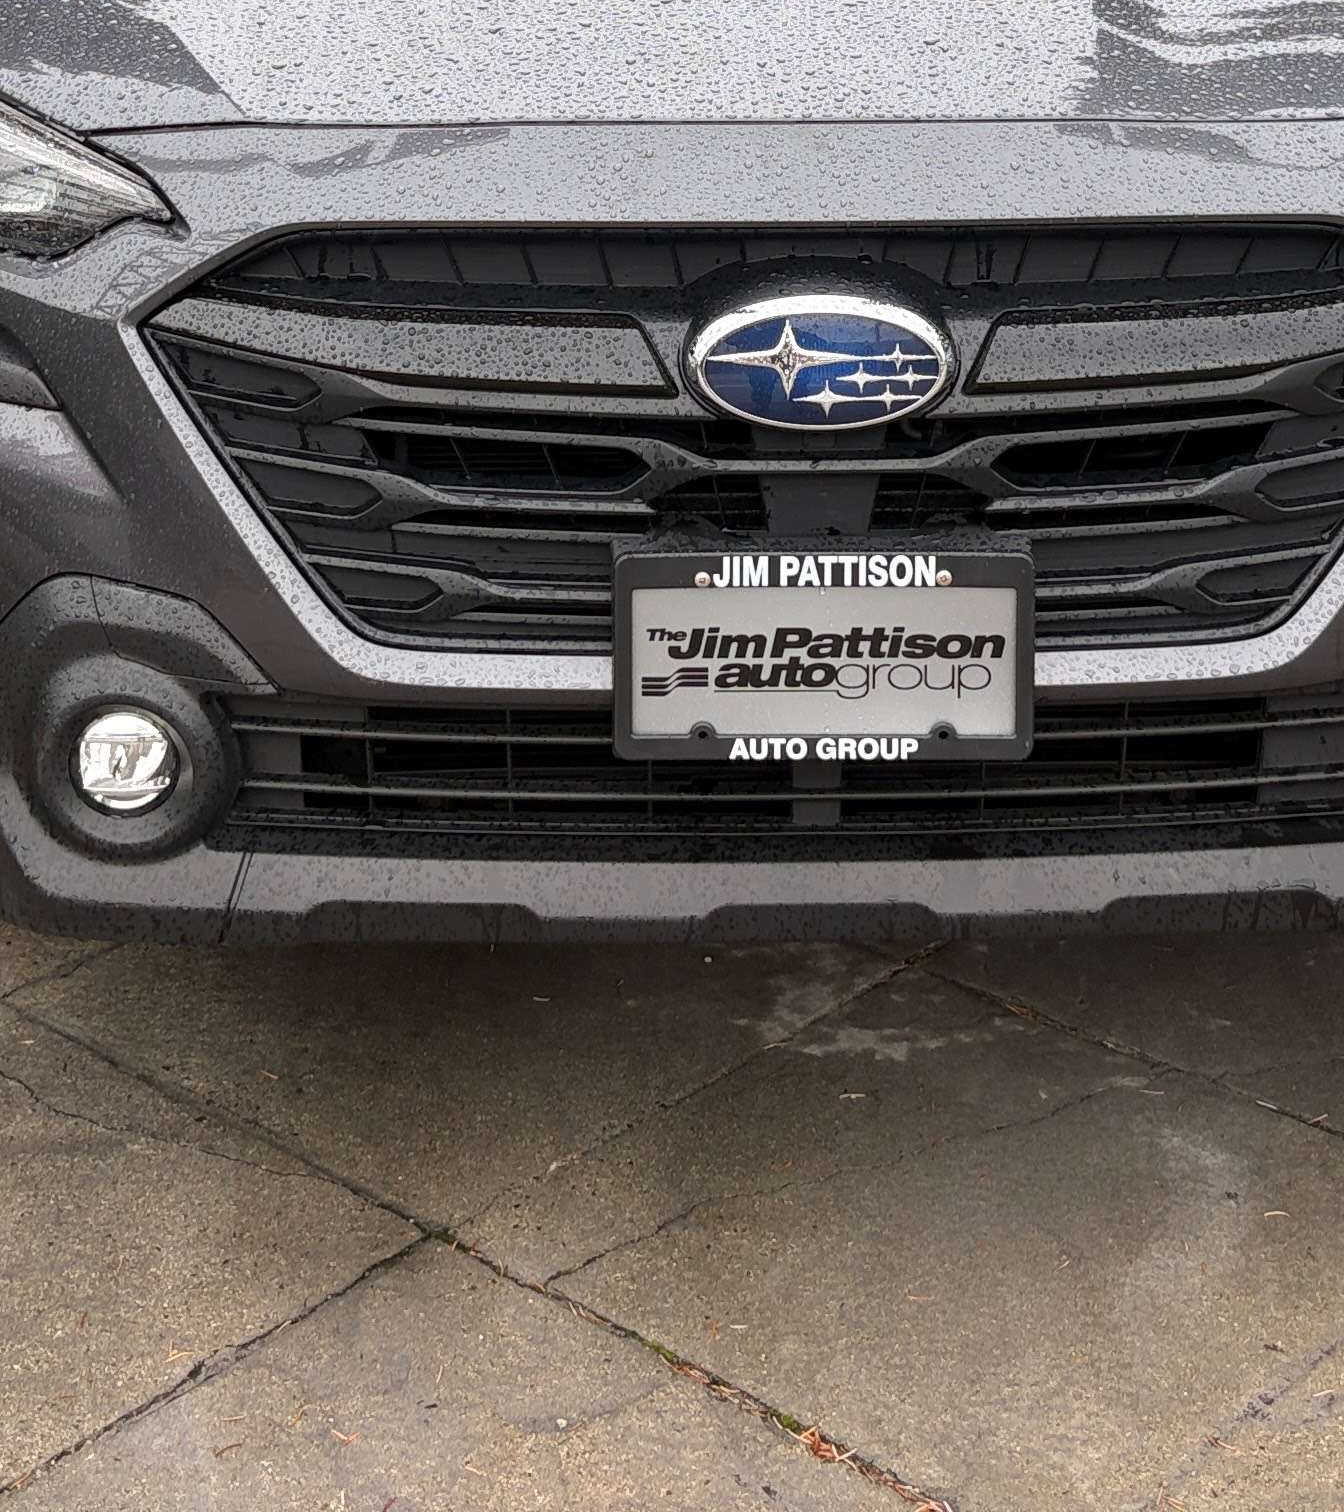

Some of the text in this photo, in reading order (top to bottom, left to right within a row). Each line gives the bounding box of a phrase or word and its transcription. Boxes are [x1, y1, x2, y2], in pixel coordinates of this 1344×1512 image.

[712, 555, 937, 587] JIM PATTISON
[646, 627, 1006, 659] The Jim Pattison
[729, 738, 919, 761] AUTO GROUP
